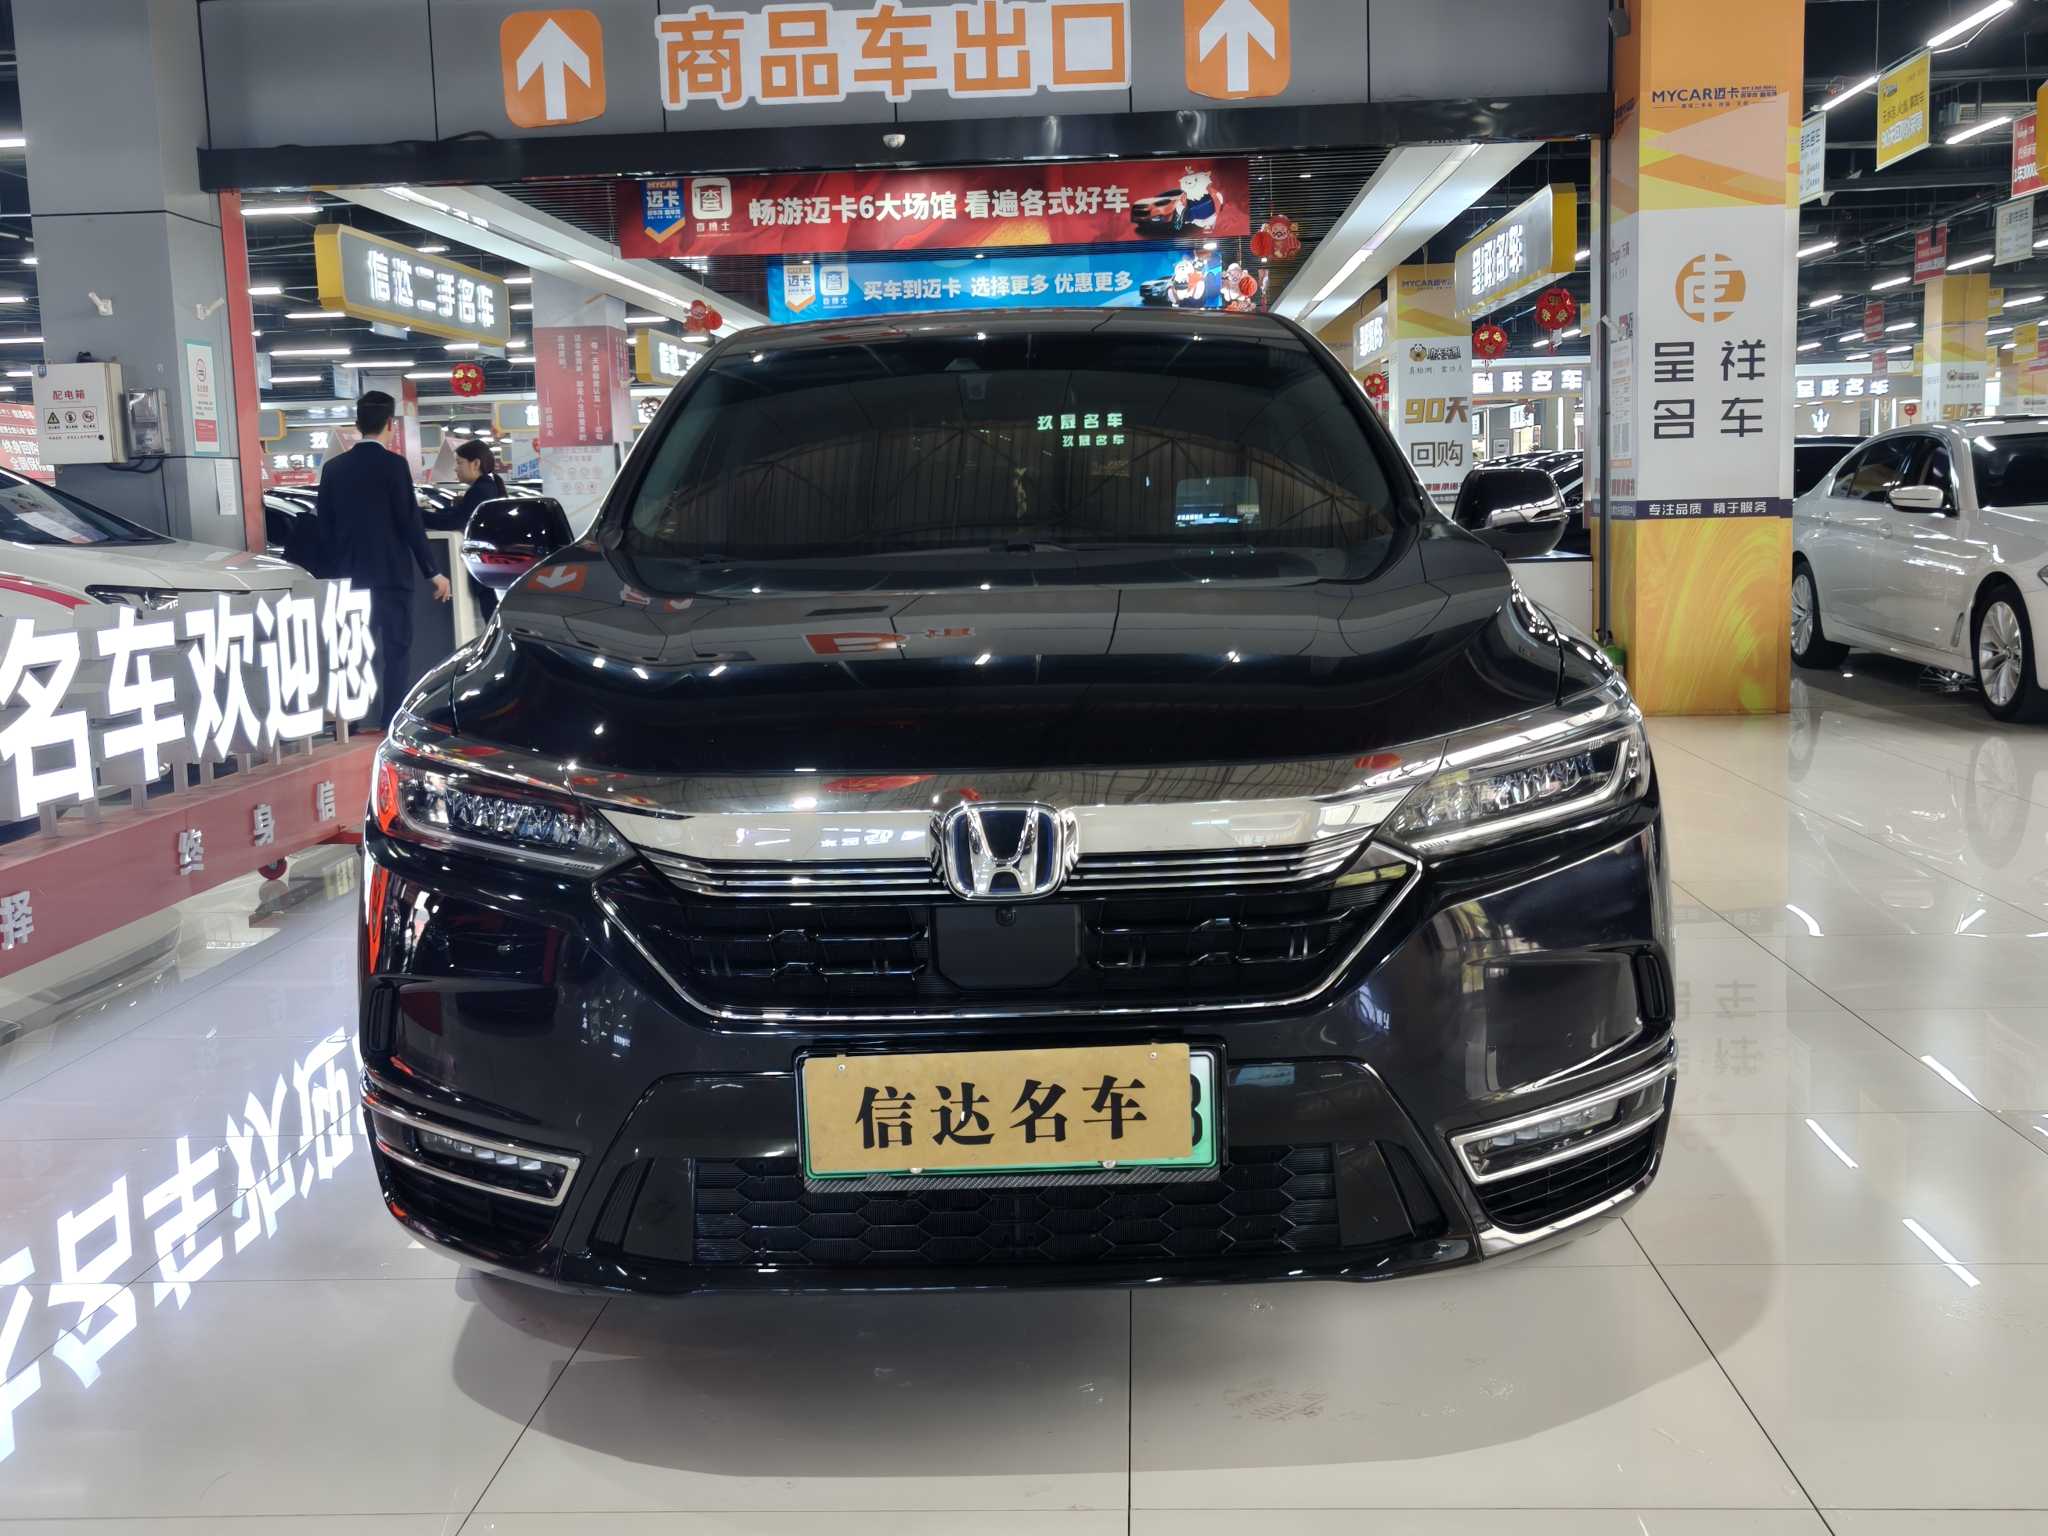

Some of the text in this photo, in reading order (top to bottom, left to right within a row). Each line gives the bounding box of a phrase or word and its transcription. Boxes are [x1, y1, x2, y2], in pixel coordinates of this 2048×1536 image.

[659, 1, 1129, 105] 商品车出口
[647, 190, 680, 207] 迈卡
[748, 185, 1130, 226] 畅游迈卡6大场馆 看遍各式好车
[367, 249, 495, 329] 信达二手名车
[788, 275, 811, 287] 迈卡
[863, 270, 1133, 303] 买车到迈卡 选择更多 优惠更多
[1653, 338, 1767, 383] 呈祥
[52, 389, 86, 401] 配电箱
[1404, 396, 1470, 424] 90天
[1653, 396, 1764, 440] 名车
[1410, 440, 1464, 468] 回购
[1649, 502, 1702, 516] 专注品质
[1713, 501, 1768, 515] 精于服务
[0, 578, 377, 818] 名车欢迎您
[855, 1075, 1147, 1149] 信达名车
